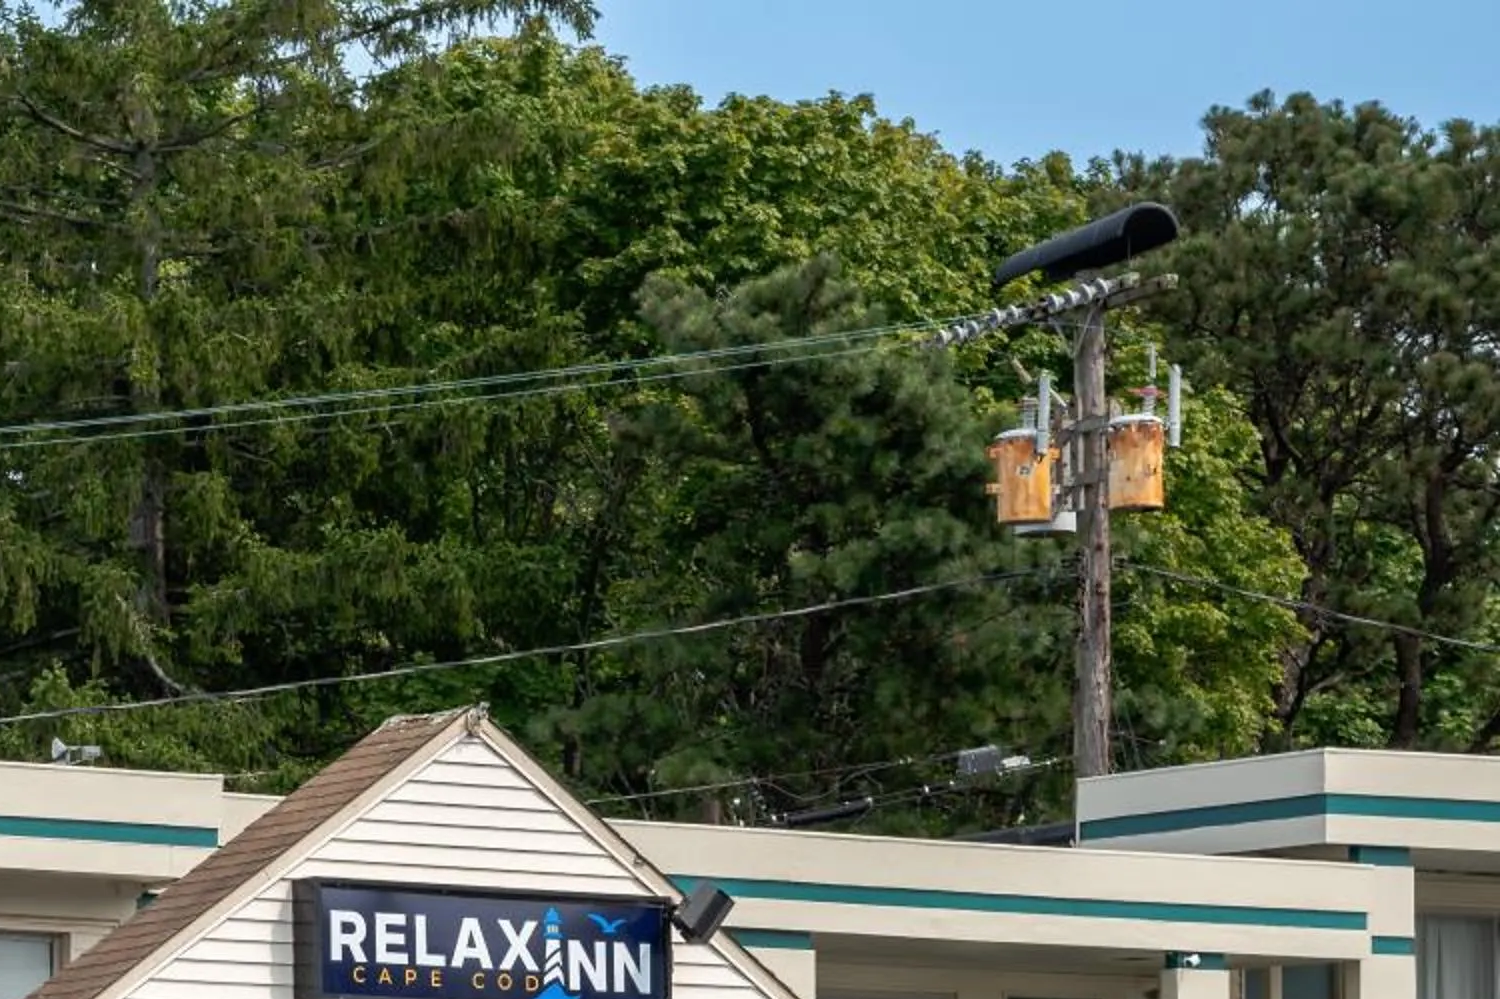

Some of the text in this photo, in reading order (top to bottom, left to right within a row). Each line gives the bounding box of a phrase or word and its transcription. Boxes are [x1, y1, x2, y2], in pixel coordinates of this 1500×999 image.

[329, 909, 540, 973] RELAX
[352, 964, 540, 993] CAPE COD
